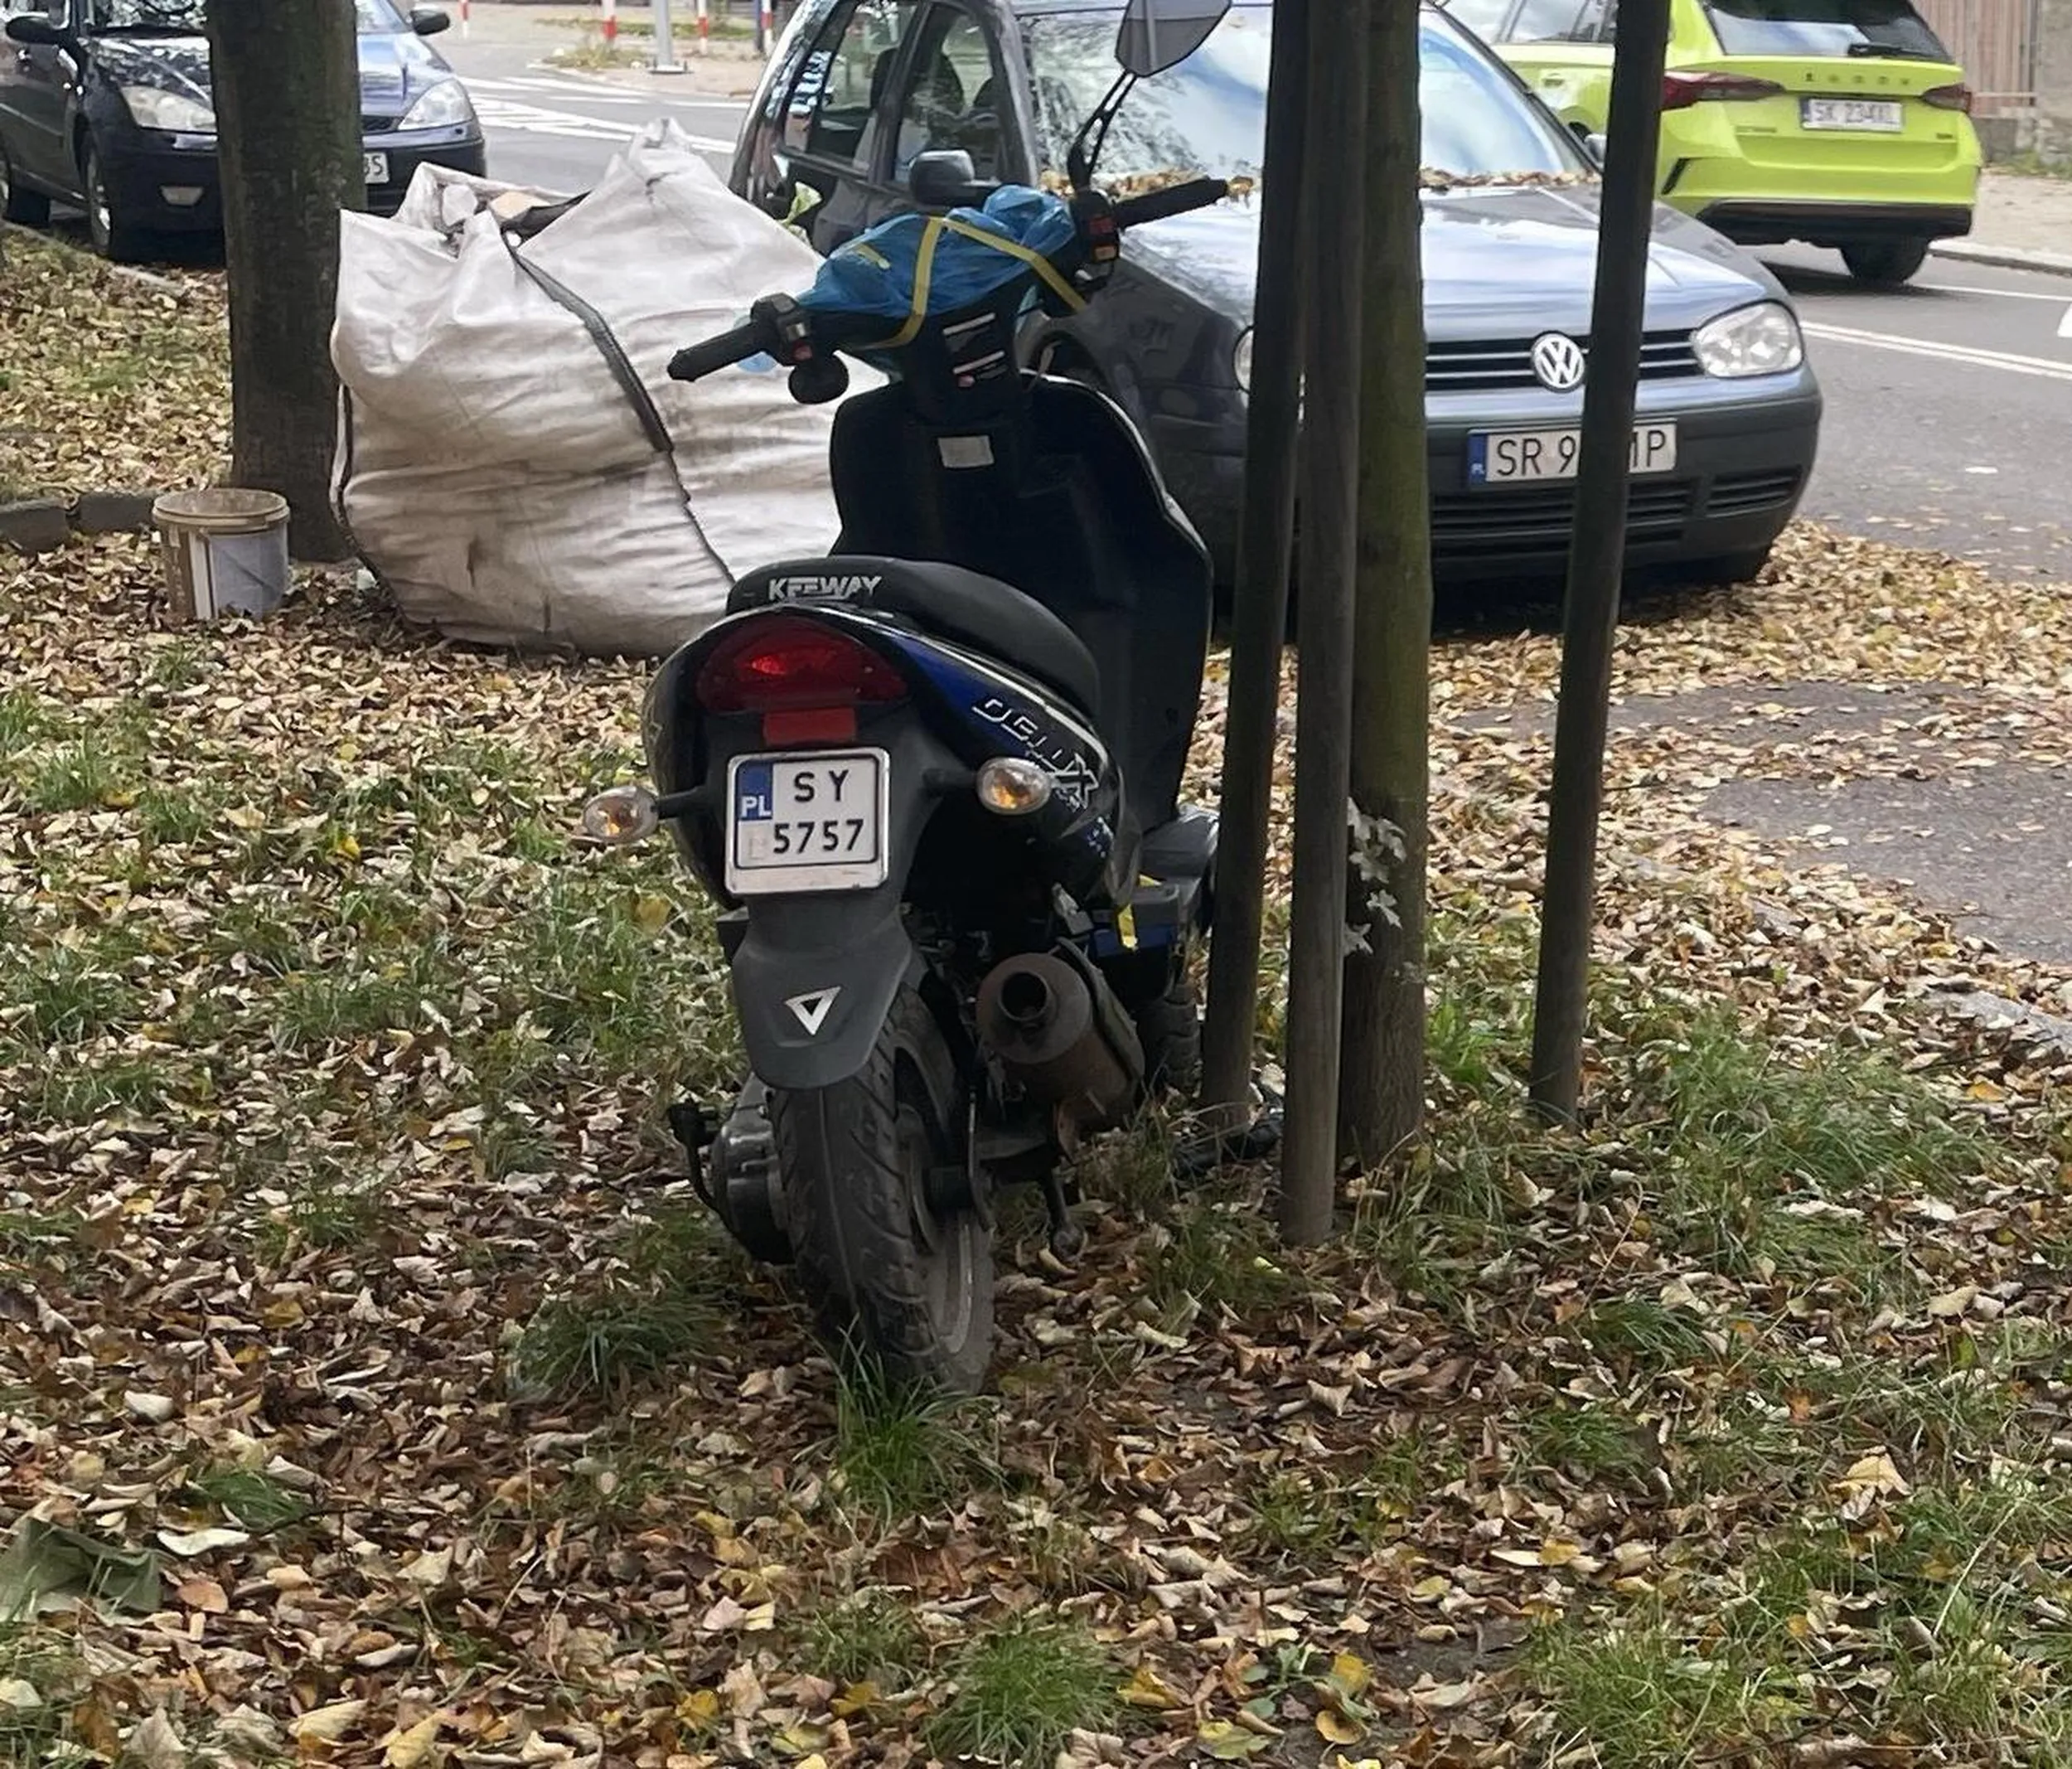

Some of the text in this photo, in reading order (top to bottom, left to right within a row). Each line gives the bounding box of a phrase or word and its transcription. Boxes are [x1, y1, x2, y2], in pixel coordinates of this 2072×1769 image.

[1496, 438, 1542, 476] SR
[793, 768, 850, 802] SY
[740, 795, 772, 818] PL
[772, 818, 864, 855] 5757
